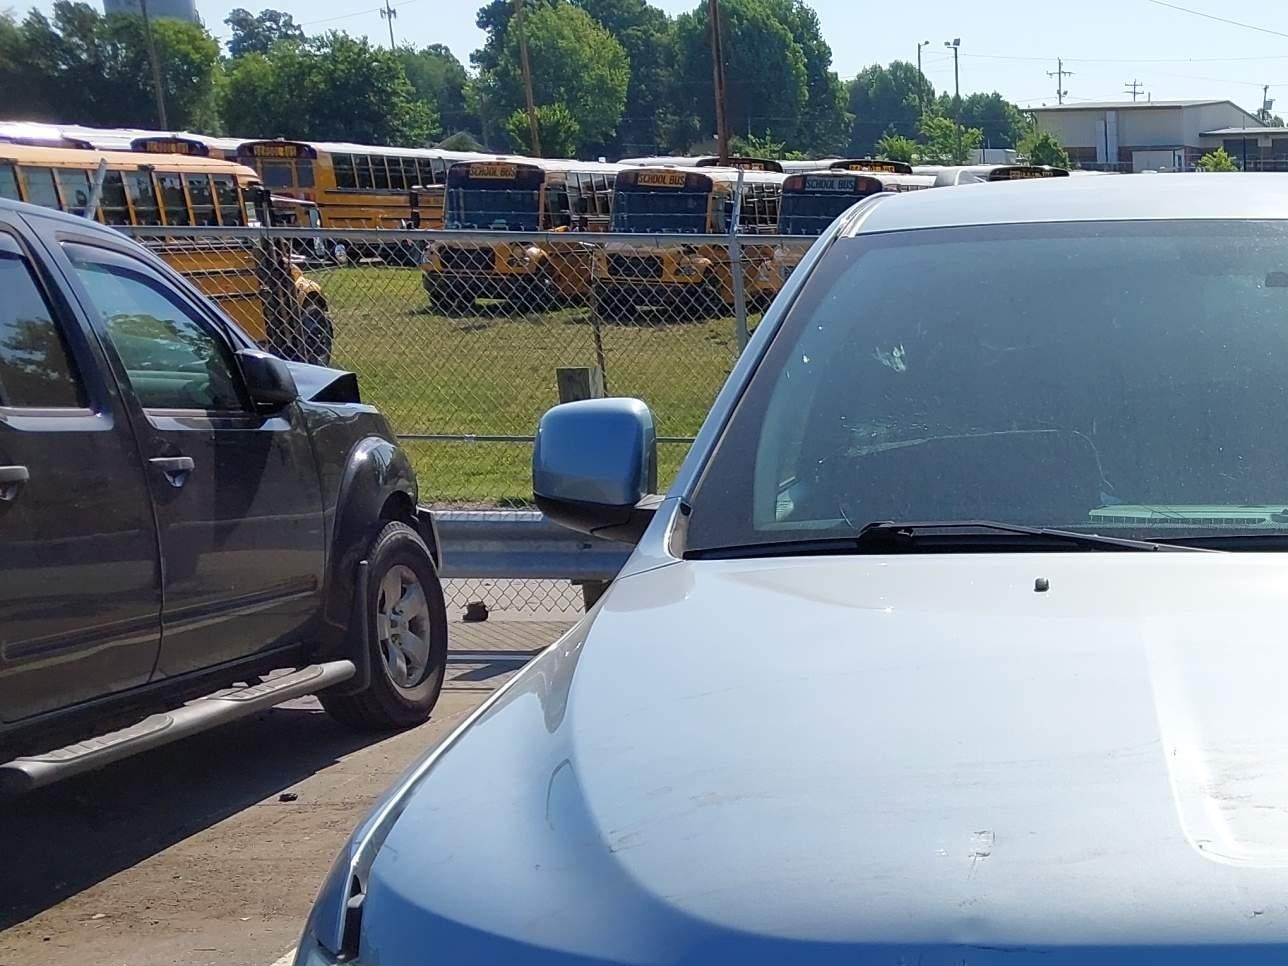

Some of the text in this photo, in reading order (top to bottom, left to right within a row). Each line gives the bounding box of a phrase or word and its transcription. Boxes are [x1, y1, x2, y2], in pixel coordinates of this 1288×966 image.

[470, 166, 516, 177] SCHOOL BUS
[638, 174, 685, 185] SCHOOL BUS
[806, 178, 855, 189] SCHOOL BUS
